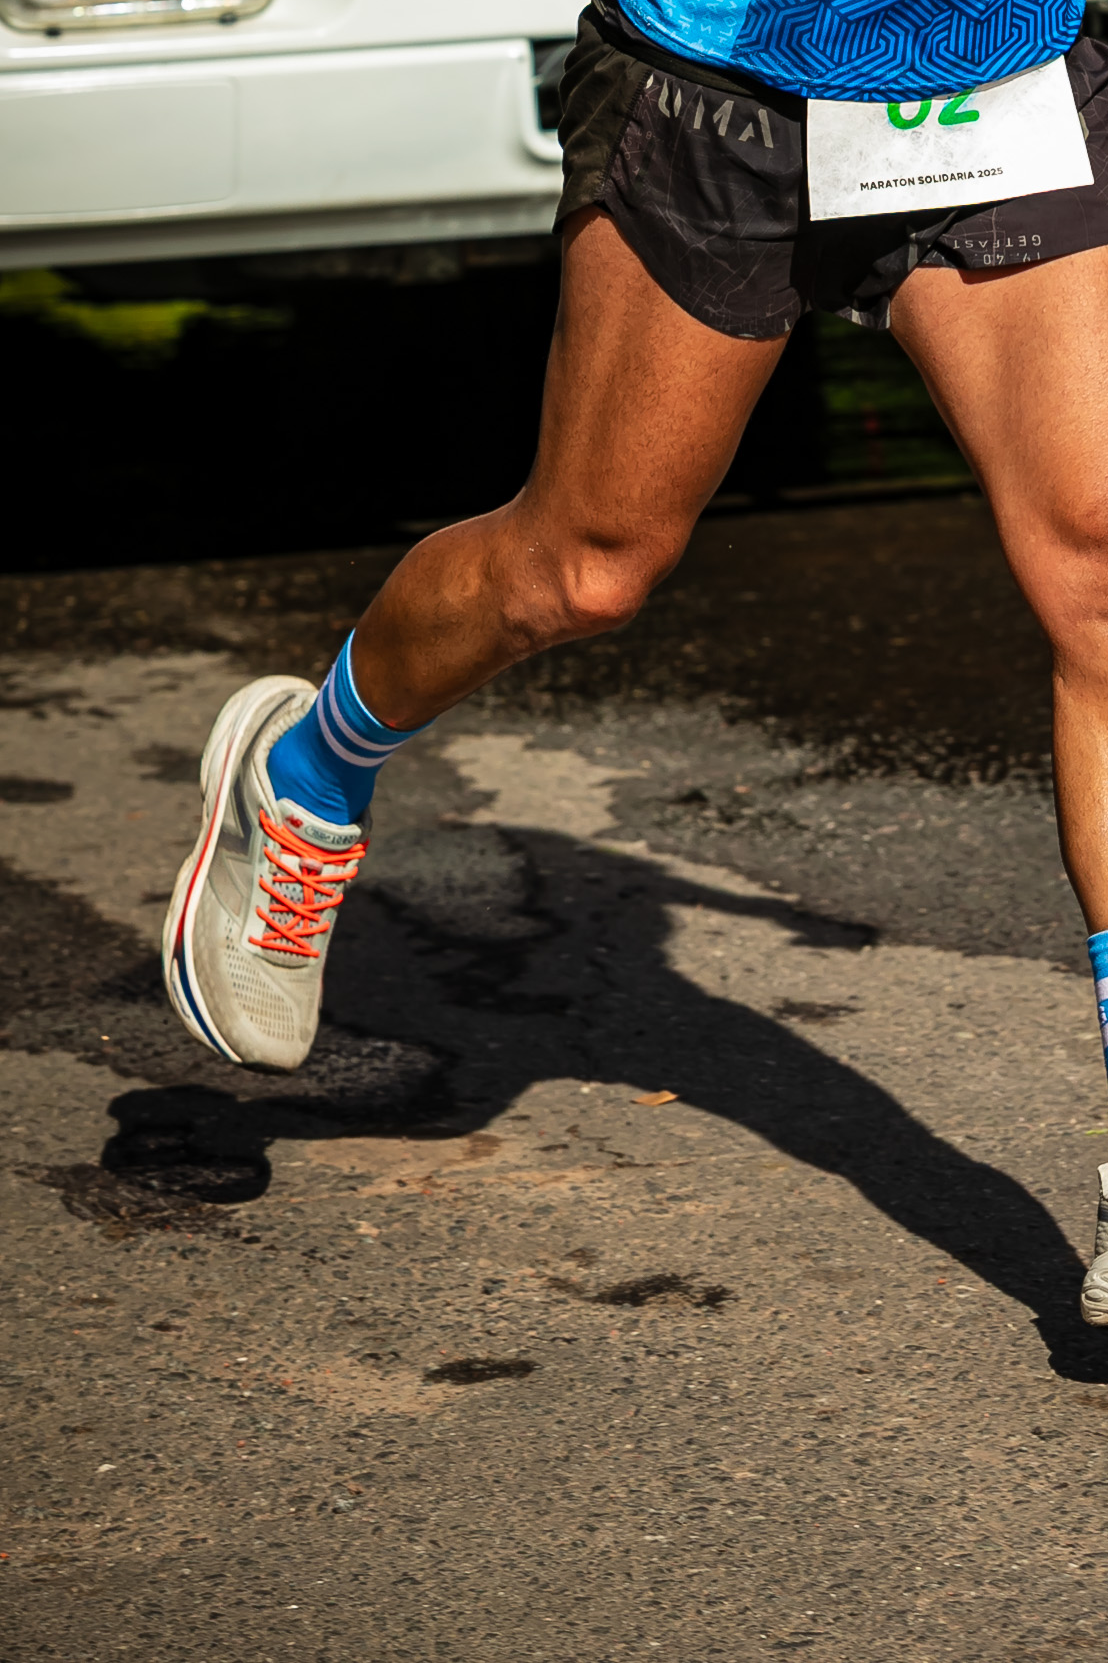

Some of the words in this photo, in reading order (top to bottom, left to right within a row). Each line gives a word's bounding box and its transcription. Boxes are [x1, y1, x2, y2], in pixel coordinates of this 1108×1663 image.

[860, 176, 916, 192] MARATON
[918, 171, 975, 185] SOLIDARIA
[977, 166, 1004, 178] 2025
